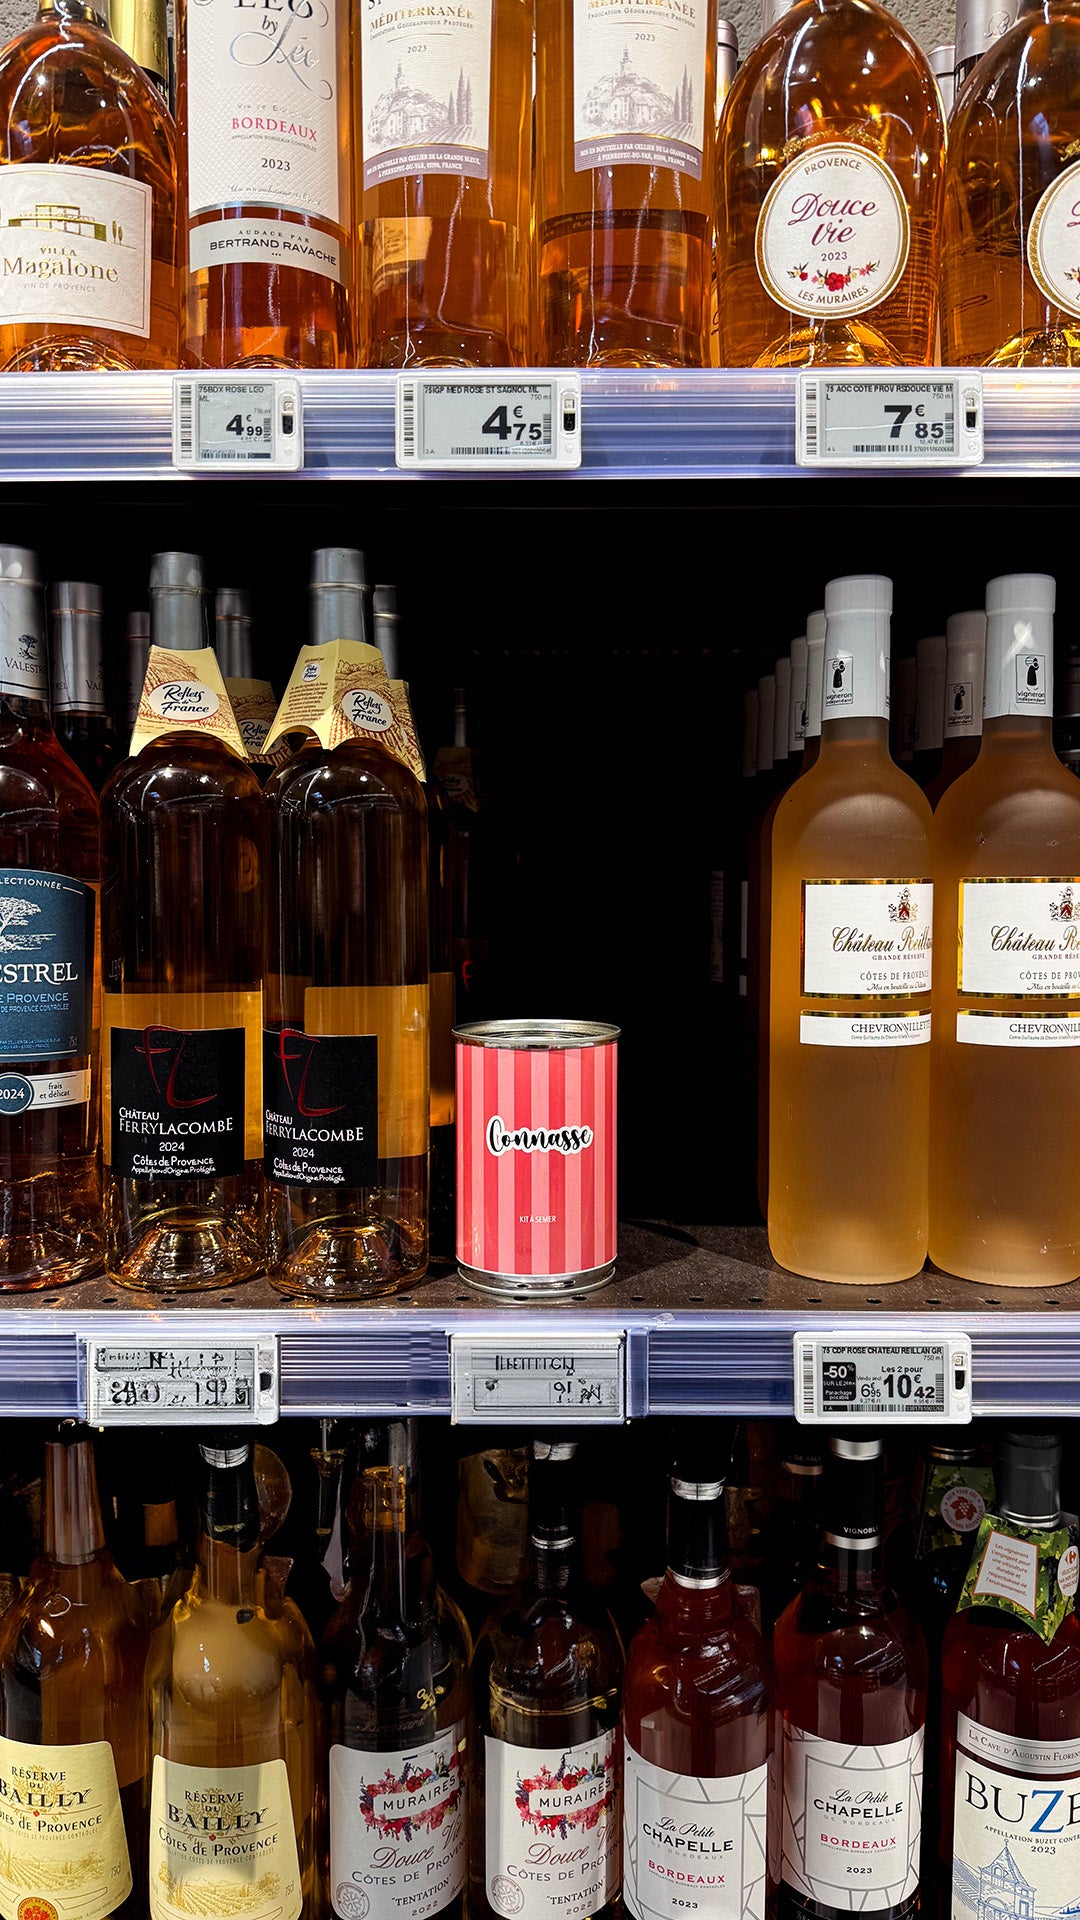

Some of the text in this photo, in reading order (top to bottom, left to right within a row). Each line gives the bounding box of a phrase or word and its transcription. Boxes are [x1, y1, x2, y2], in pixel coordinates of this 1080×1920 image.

[262, 15, 278, 36] by
[370, 5, 474, 32] MÉDITERRANÉE
[232, 117, 317, 142] BORDEAUX
[262, 158, 291, 171] 2023
[804, 157, 863, 175] PROVENCE
[787, 193, 879, 226] Douce
[290, 234, 310, 243] PAR
[811, 219, 856, 247] Vie
[40, 246, 77, 257] VILLA
[210, 238, 336, 266] BERTRAND RAVACHE
[821, 251, 848, 262] 2023
[3, 256, 118, 283] Magalone
[53, 283, 96, 292] PROVENCE
[797, 286, 869, 304] LES MURAIRES
[463, 386, 484, 394] ROSE
[162, 684, 205, 702] Reflets
[161, 701, 210, 714] France
[352, 691, 383, 714] Reflets
[352, 709, 387, 726] France
[832, 926, 894, 952] Château
[991, 925, 1055, 952] Château
[0, 962, 78, 985] STREL
[860, 970, 900, 980] CÔTES DE
[1019, 969, 1061, 980] CÔTES DE
[7, 992, 69, 1003] PROVENCE
[48, 1089, 71, 1098] délicat
[49, 1082, 63, 1090] frais
[119, 1107, 160, 1120] CHÂTEAU
[265, 1109, 293, 1125] CHÂTEAU
[119, 1117, 233, 1135] FERRYLACOMBE
[266, 1121, 364, 1142] FERRYLACOMBE
[489, 1118, 592, 1152] Connasse
[159, 1141, 185, 1151] 2024
[292, 1147, 315, 1158] 2024
[11, 1766, 66, 1781] RÉSERVE
[184, 1790, 244, 1803] RÉSERVE
[383, 1776, 456, 1811] MURAIRES
[539, 1776, 611, 1809] MURAIRES
[829, 1789, 889, 1804] La Petite
[167, 1802, 269, 1831] BAILLY
[814, 1798, 903, 1818] CHAPELLE
[38, 1814, 102, 1833] PROVENCE
[656, 1817, 715, 1838] La Petite
[843, 1818, 895, 1826] BORDEAUX
[642, 1823, 733, 1853] CHAPELLE
[820, 1833, 896, 1849] BORDEAUX
[984, 1824, 1033, 1843] APPELLATION
[214, 1833, 278, 1856] PROVENCE
[1031, 1846, 1056, 1855] 2023
[370, 1845, 436, 1870] Douce
[525, 1842, 590, 1866] Douce
[352, 1871, 420, 1885] CÔTES DE
[507, 1864, 575, 1882] CÔTES DE
[648, 1860, 725, 1884] BORDEAUX
[846, 1866, 873, 1874] 2023
[412, 1900, 439, 1916] 2022
[566, 1901, 592, 1915] 2022
[671, 1898, 698, 1909] 2023
